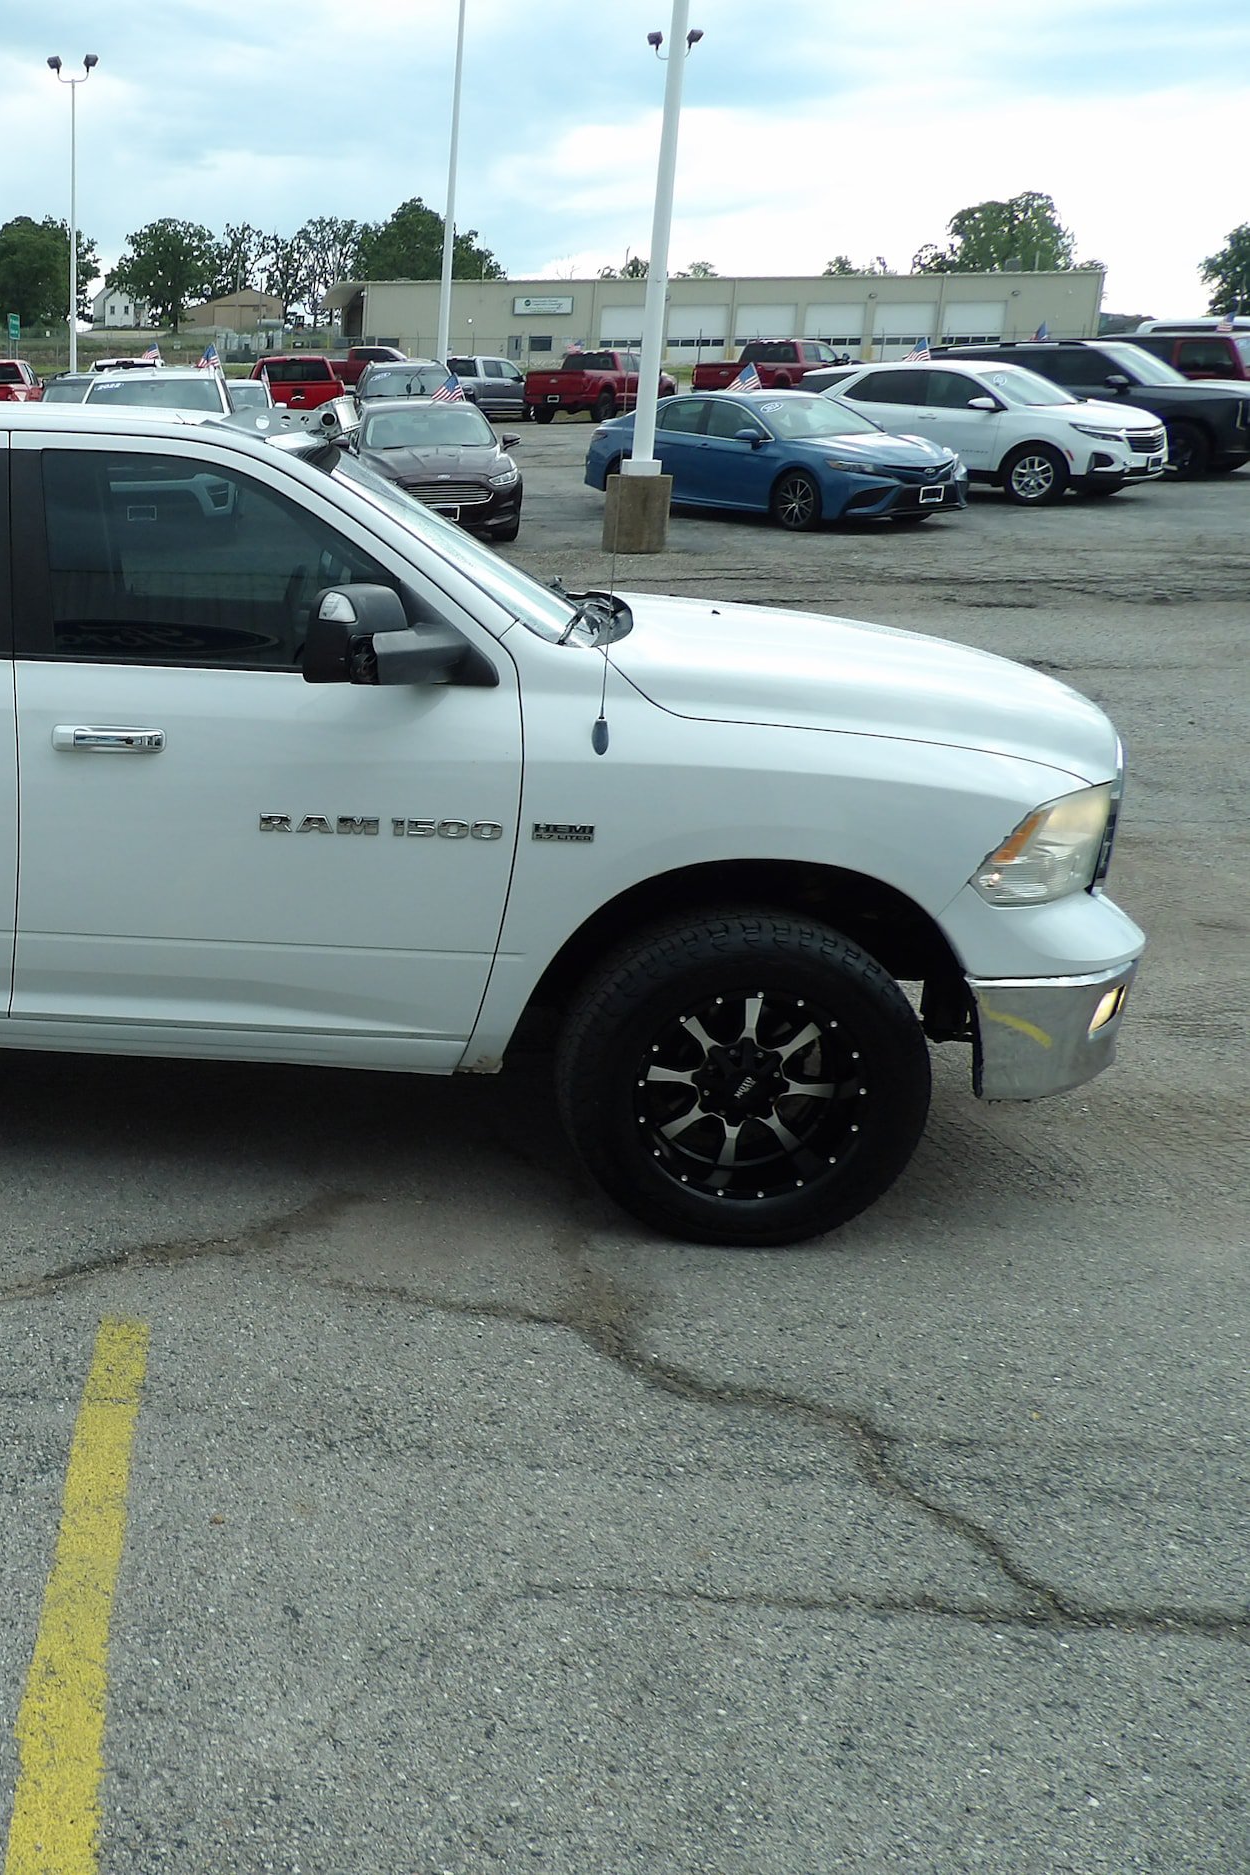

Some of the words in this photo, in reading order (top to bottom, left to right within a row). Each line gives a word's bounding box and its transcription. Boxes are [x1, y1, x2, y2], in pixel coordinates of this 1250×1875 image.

[259, 813, 380, 836] RAM
[391, 818, 503, 840] 1500
[533, 822, 595, 834] HEMI
